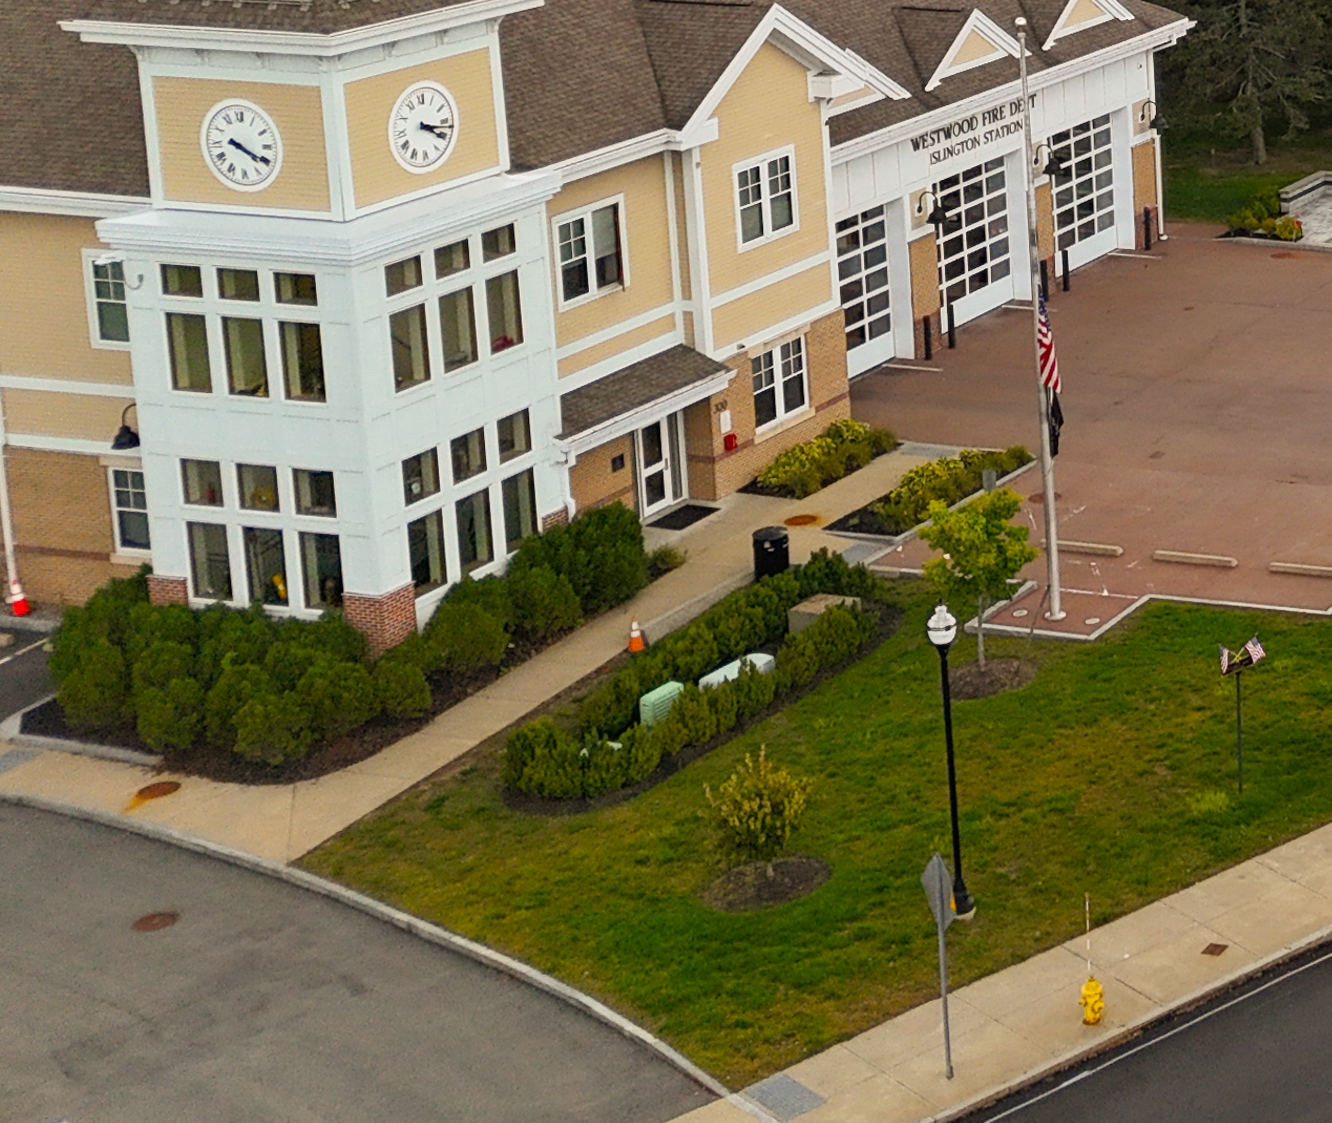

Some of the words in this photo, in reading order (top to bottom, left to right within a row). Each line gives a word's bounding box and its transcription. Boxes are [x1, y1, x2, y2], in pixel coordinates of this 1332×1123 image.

[910, 114, 979, 152] WESTWOOD
[982, 105, 1006, 126] FIRE
[1010, 93, 1037, 116] DET
[930, 134, 981, 165] ISLINGTON
[983, 118, 1024, 145] STATION
